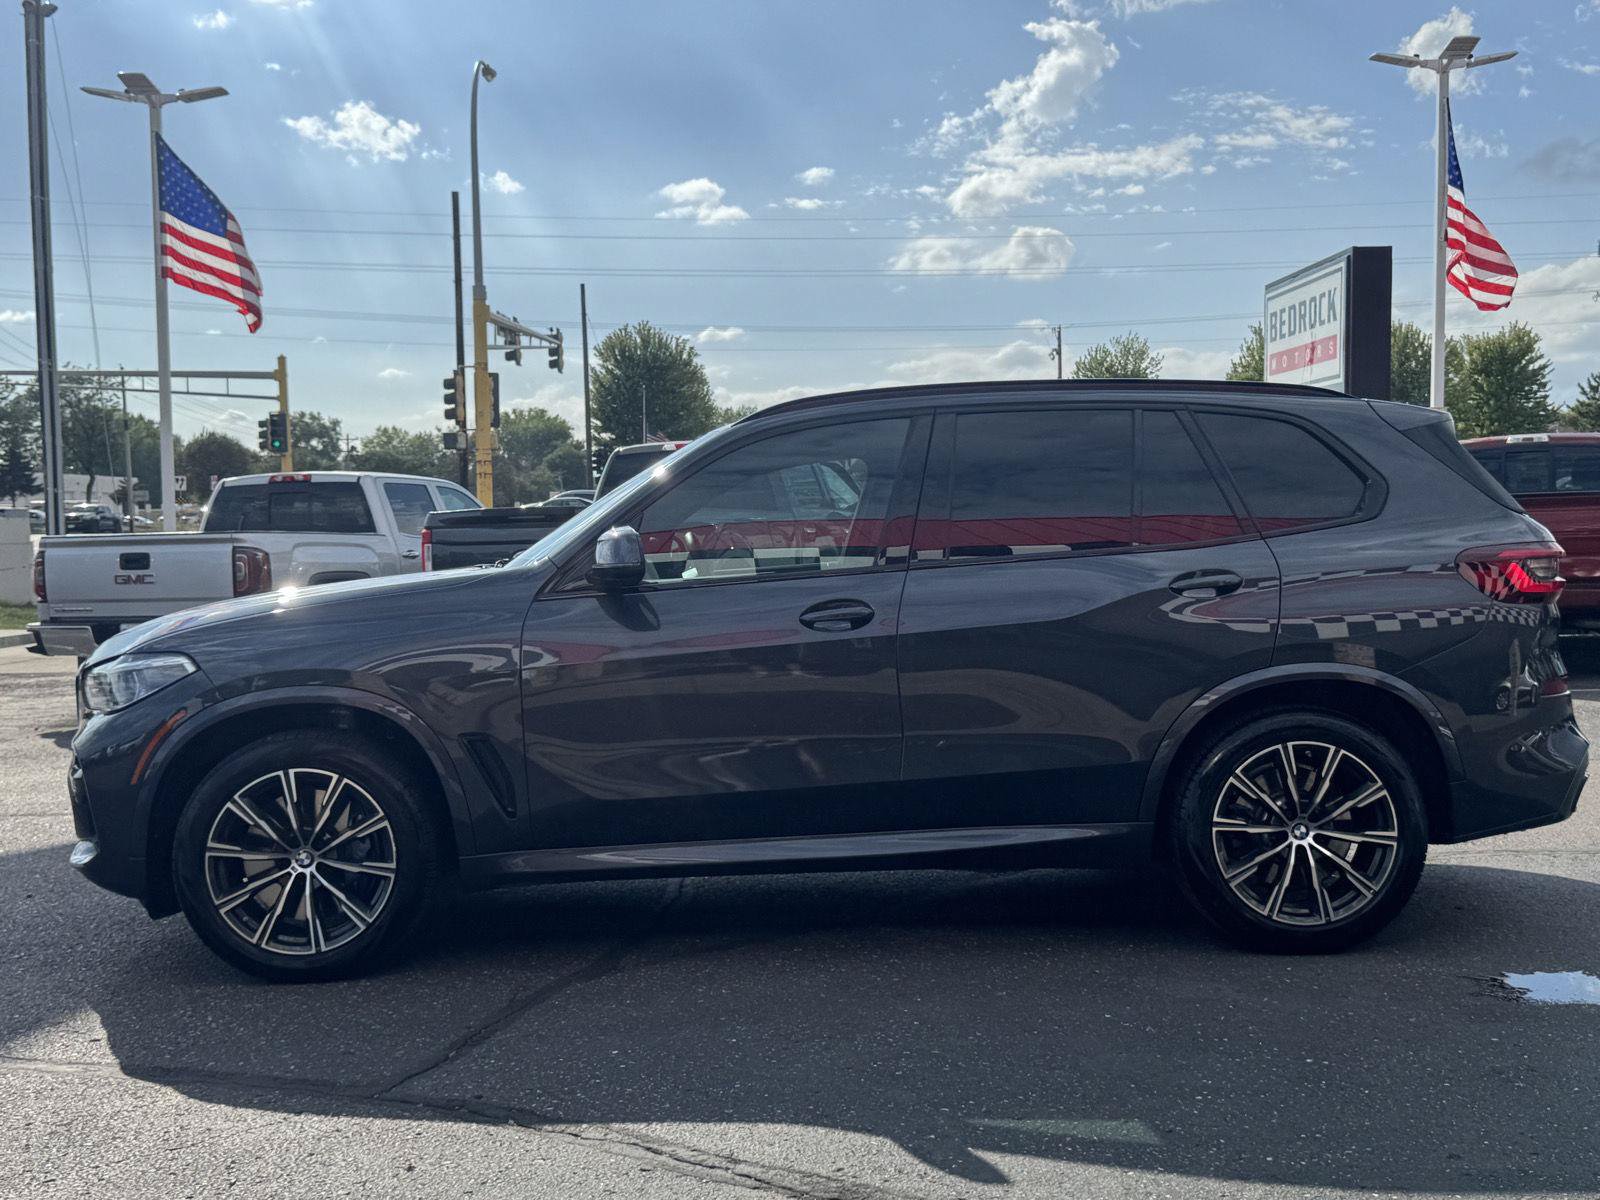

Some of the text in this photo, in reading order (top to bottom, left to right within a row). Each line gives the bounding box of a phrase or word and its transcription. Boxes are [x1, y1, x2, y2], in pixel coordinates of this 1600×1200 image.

[1269, 287, 1338, 343] BEDROCK
[1271, 341, 1334, 370] MOTORS
[114, 574, 155, 585] GMC
